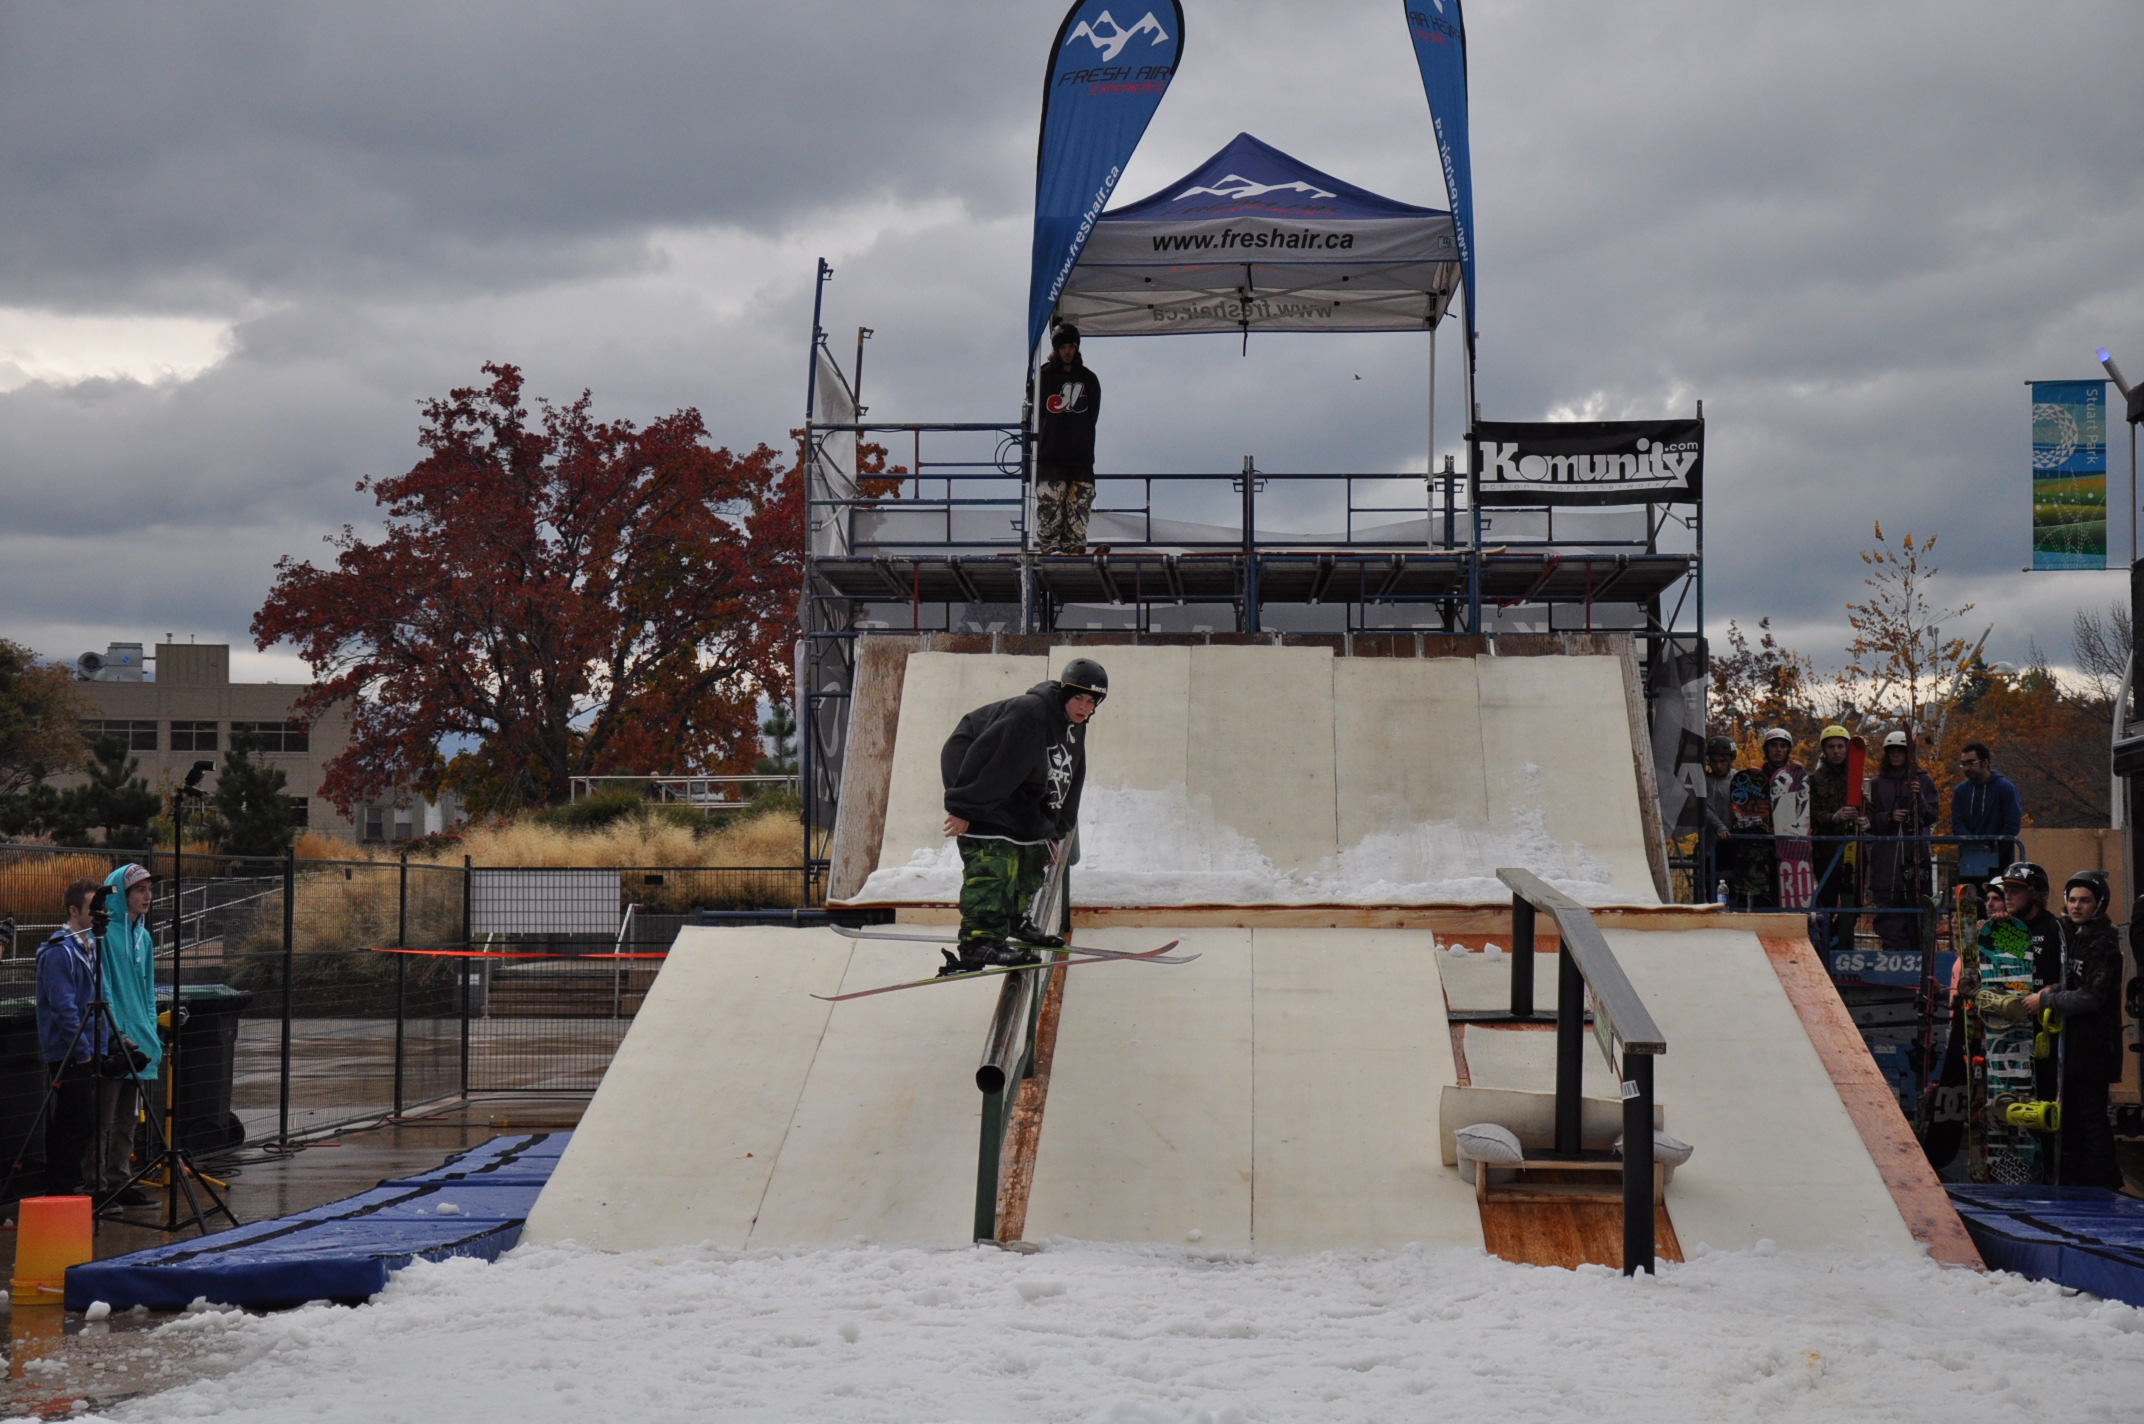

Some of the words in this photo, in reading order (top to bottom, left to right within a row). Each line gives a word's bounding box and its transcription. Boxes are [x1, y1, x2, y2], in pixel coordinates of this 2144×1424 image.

[1058, 66, 1132, 87] FRESH
[1136, 66, 1172, 80] AIR
[1048, 165, 1120, 302] www.freshair.ca
[1152, 228, 1354, 251] www.freshair.ca
[2086, 388, 2099, 431] Stuart
[1479, 437, 1699, 488] Komunity
[2086, 434, 2099, 465] Park
